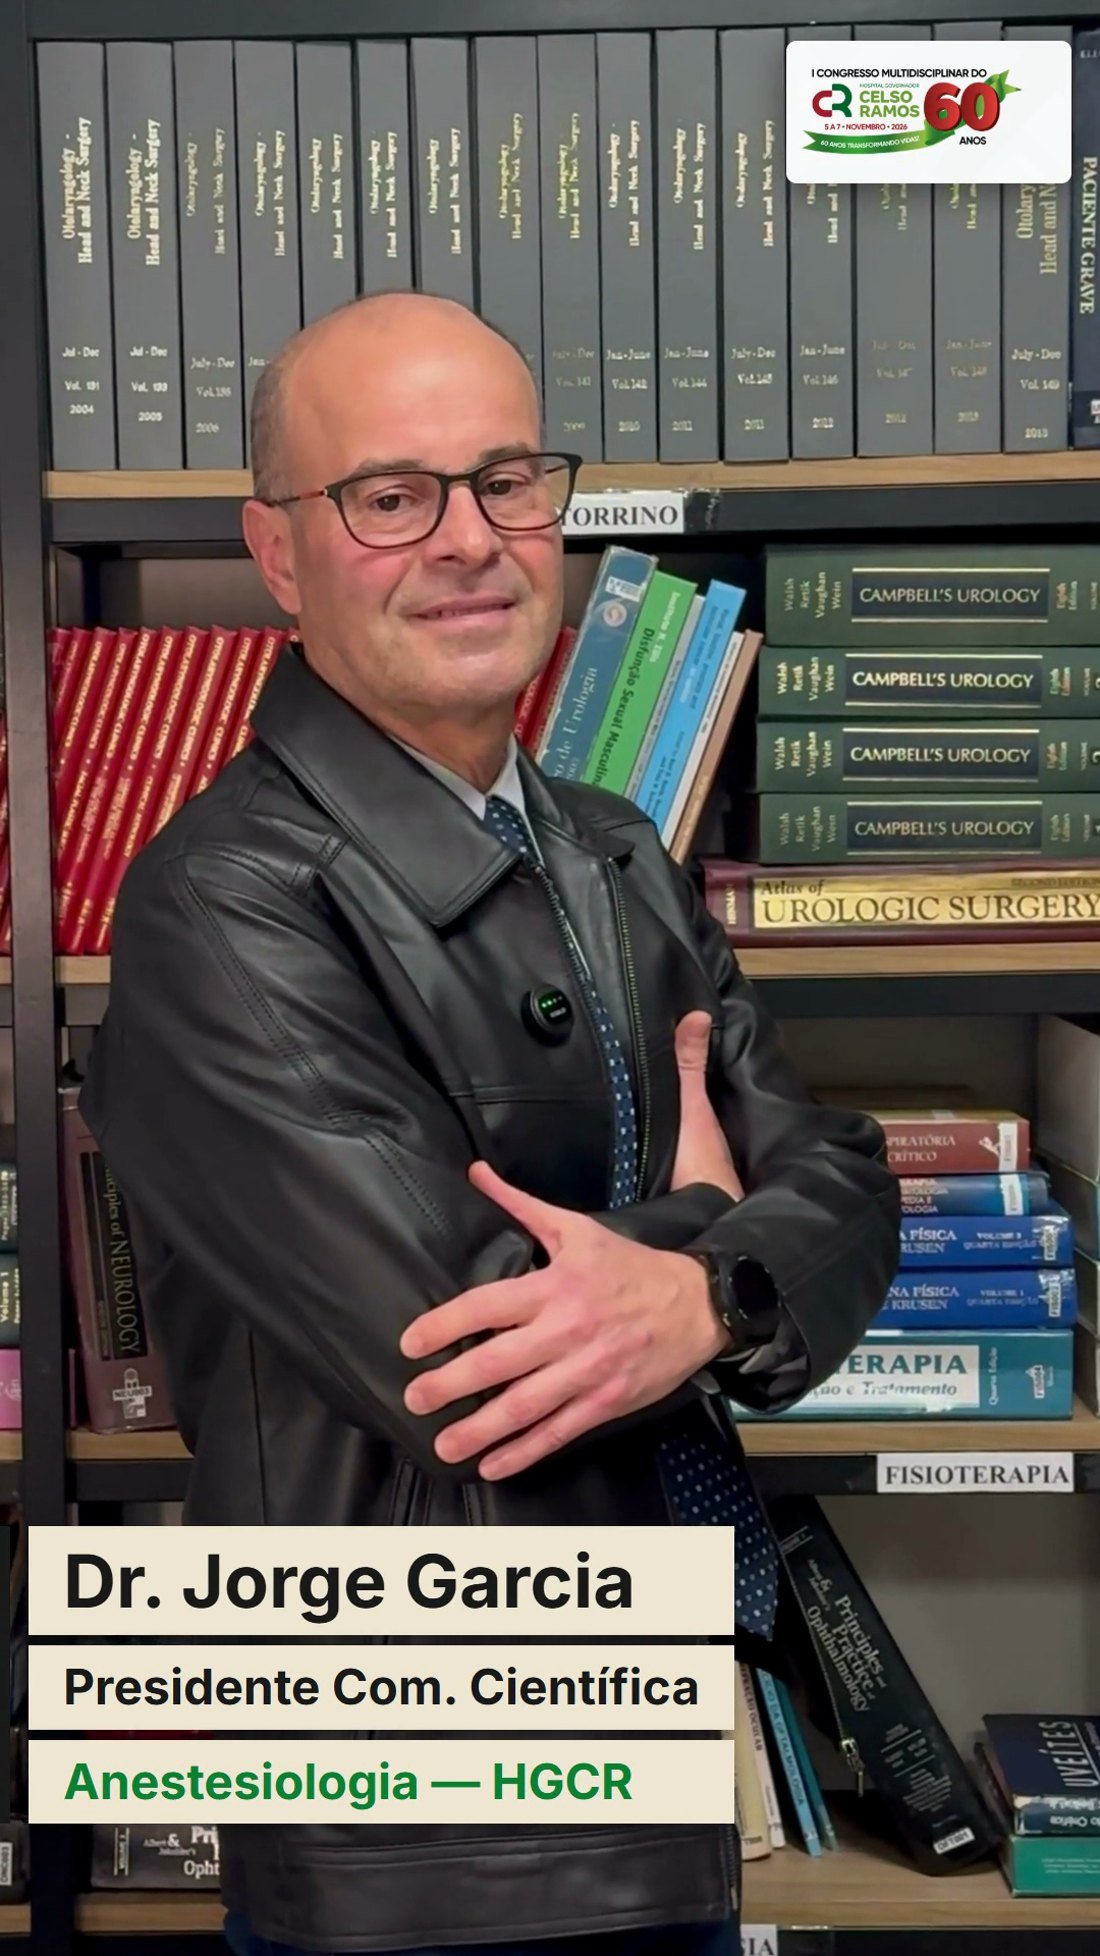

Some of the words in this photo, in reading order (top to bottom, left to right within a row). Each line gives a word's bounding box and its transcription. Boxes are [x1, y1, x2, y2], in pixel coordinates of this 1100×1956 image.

[77, 117, 91, 165] Surgery
[144, 119, 160, 167] Surgery
[60, 148, 76, 238] Otolaryngology
[76, 170, 90, 201] Neck
[126, 148, 142, 238] Otolaryngology
[145, 172, 158, 202] Neck
[78, 206, 91, 227] and
[1039, 201, 1057, 229] and
[1081, 156, 1097, 248] PACIENTE
[147, 208, 159, 229] and
[78, 233, 92, 263] Head
[146, 234, 160, 265] Head
[1040, 234, 1057, 274] Head
[1080, 252, 1095, 314] GRAVE
[62, 347, 75, 357] Jul
[83, 347, 100, 357] Dec
[130, 346, 144, 357] Jul
[151, 346, 167, 357] Dec
[70, 404, 94, 414] 2004
[138, 412, 162, 421] 2005
[561, 506, 678, 526] ORRINO
[784, 578, 794, 611] Walsh
[816, 572, 825, 618] Vaughan
[832, 581, 841, 609] Wein
[859, 587, 952, 602] CAMPBELL'S
[957, 588, 1040, 603] UROLOGY
[625, 627, 655, 687] Disfunção
[776, 662, 787, 695] Walsh
[809, 657, 819, 701] Vaughan
[825, 665, 835, 691] Wein
[852, 671, 946, 687] CAMPBELL'S
[951, 674, 1034, 688] UROLOGY
[556, 740, 572, 759] de
[564, 667, 597, 735] Urologia
[612, 689, 635, 729] Sexual
[775, 737, 785, 770] Walsh
[807, 731, 816, 776] Vaughan
[823, 740, 832, 767] Wein
[850, 748, 943, 762] CAMPBELL'S
[948, 748, 1030, 763] UROLOGY
[854, 821, 946, 836] CAMPBELL'S
[952, 821, 1034, 836] UROLOGY
[761, 879, 802, 895] Atlas
[808, 879, 826, 895] of
[763, 896, 940, 923] UROLOGIC
[949, 894, 1100, 920] SURGERY
[910, 1227, 957, 1240] FÍSICA
[110, 1240, 140, 1353] NEUROLOGY
[892, 1300, 948, 1310] KRUSEN
[913, 1284, 960, 1297] FÍSICA
[885, 1465, 1069, 1484] FISIOTERAPIA
[835, 1595, 884, 1675] Principles
[807, 1606, 870, 1712] Ophthalmology
[833, 1624, 874, 1691] Practice
